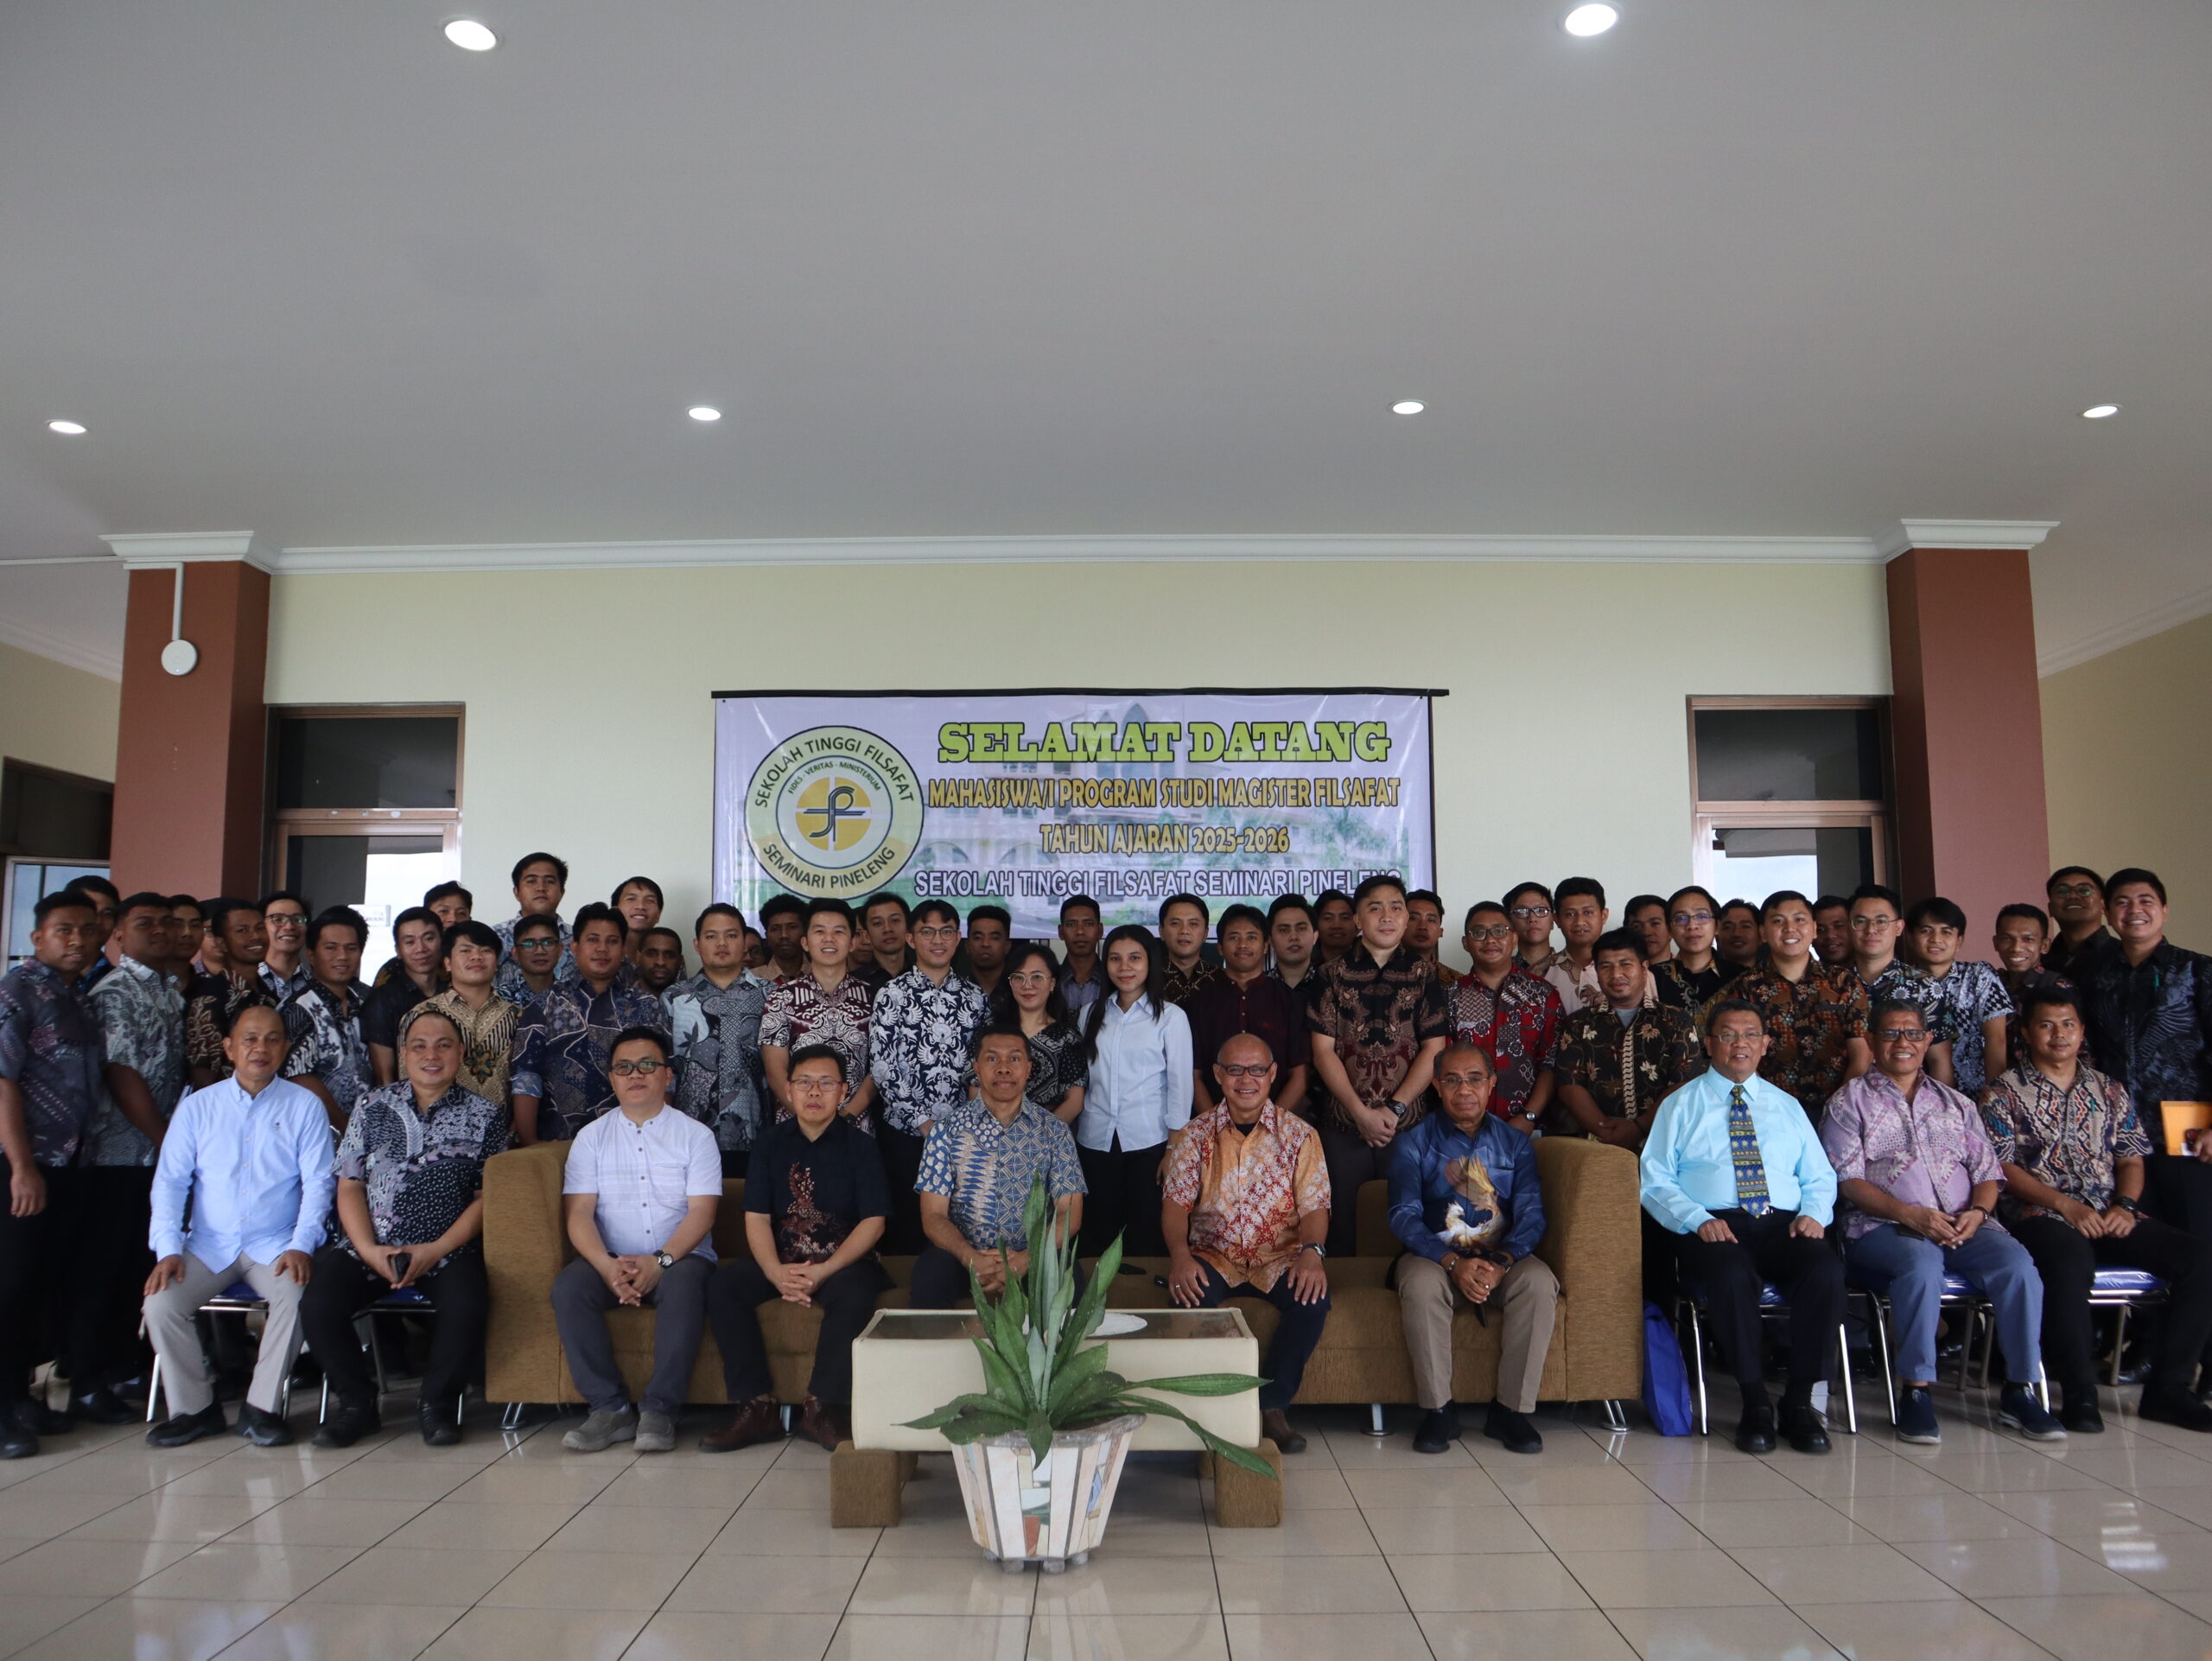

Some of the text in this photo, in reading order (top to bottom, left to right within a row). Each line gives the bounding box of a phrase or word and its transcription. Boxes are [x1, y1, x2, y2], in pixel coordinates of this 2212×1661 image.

[938, 721, 1392, 763] SELAMAT DATANG
[755, 736, 913, 807] SEKOLAH TINGGI FILSAFAT
[787, 776, 804, 794] FIDES
[804, 761, 834, 775] VERITAS
[839, 761, 881, 791] MINISTERIUM
[928, 778, 1401, 809] MAHASISWA/I PROGRAM STUDI MAGISTER FILSAFAT
[1039, 824, 1290, 857] TAHUN AJARAN 2025-2026
[763, 843, 895, 888] SEMINARI PINELENG
[914, 869, 1402, 897] SEKOLAH TINGGI FILSAFAT SEMINARI PINELE
